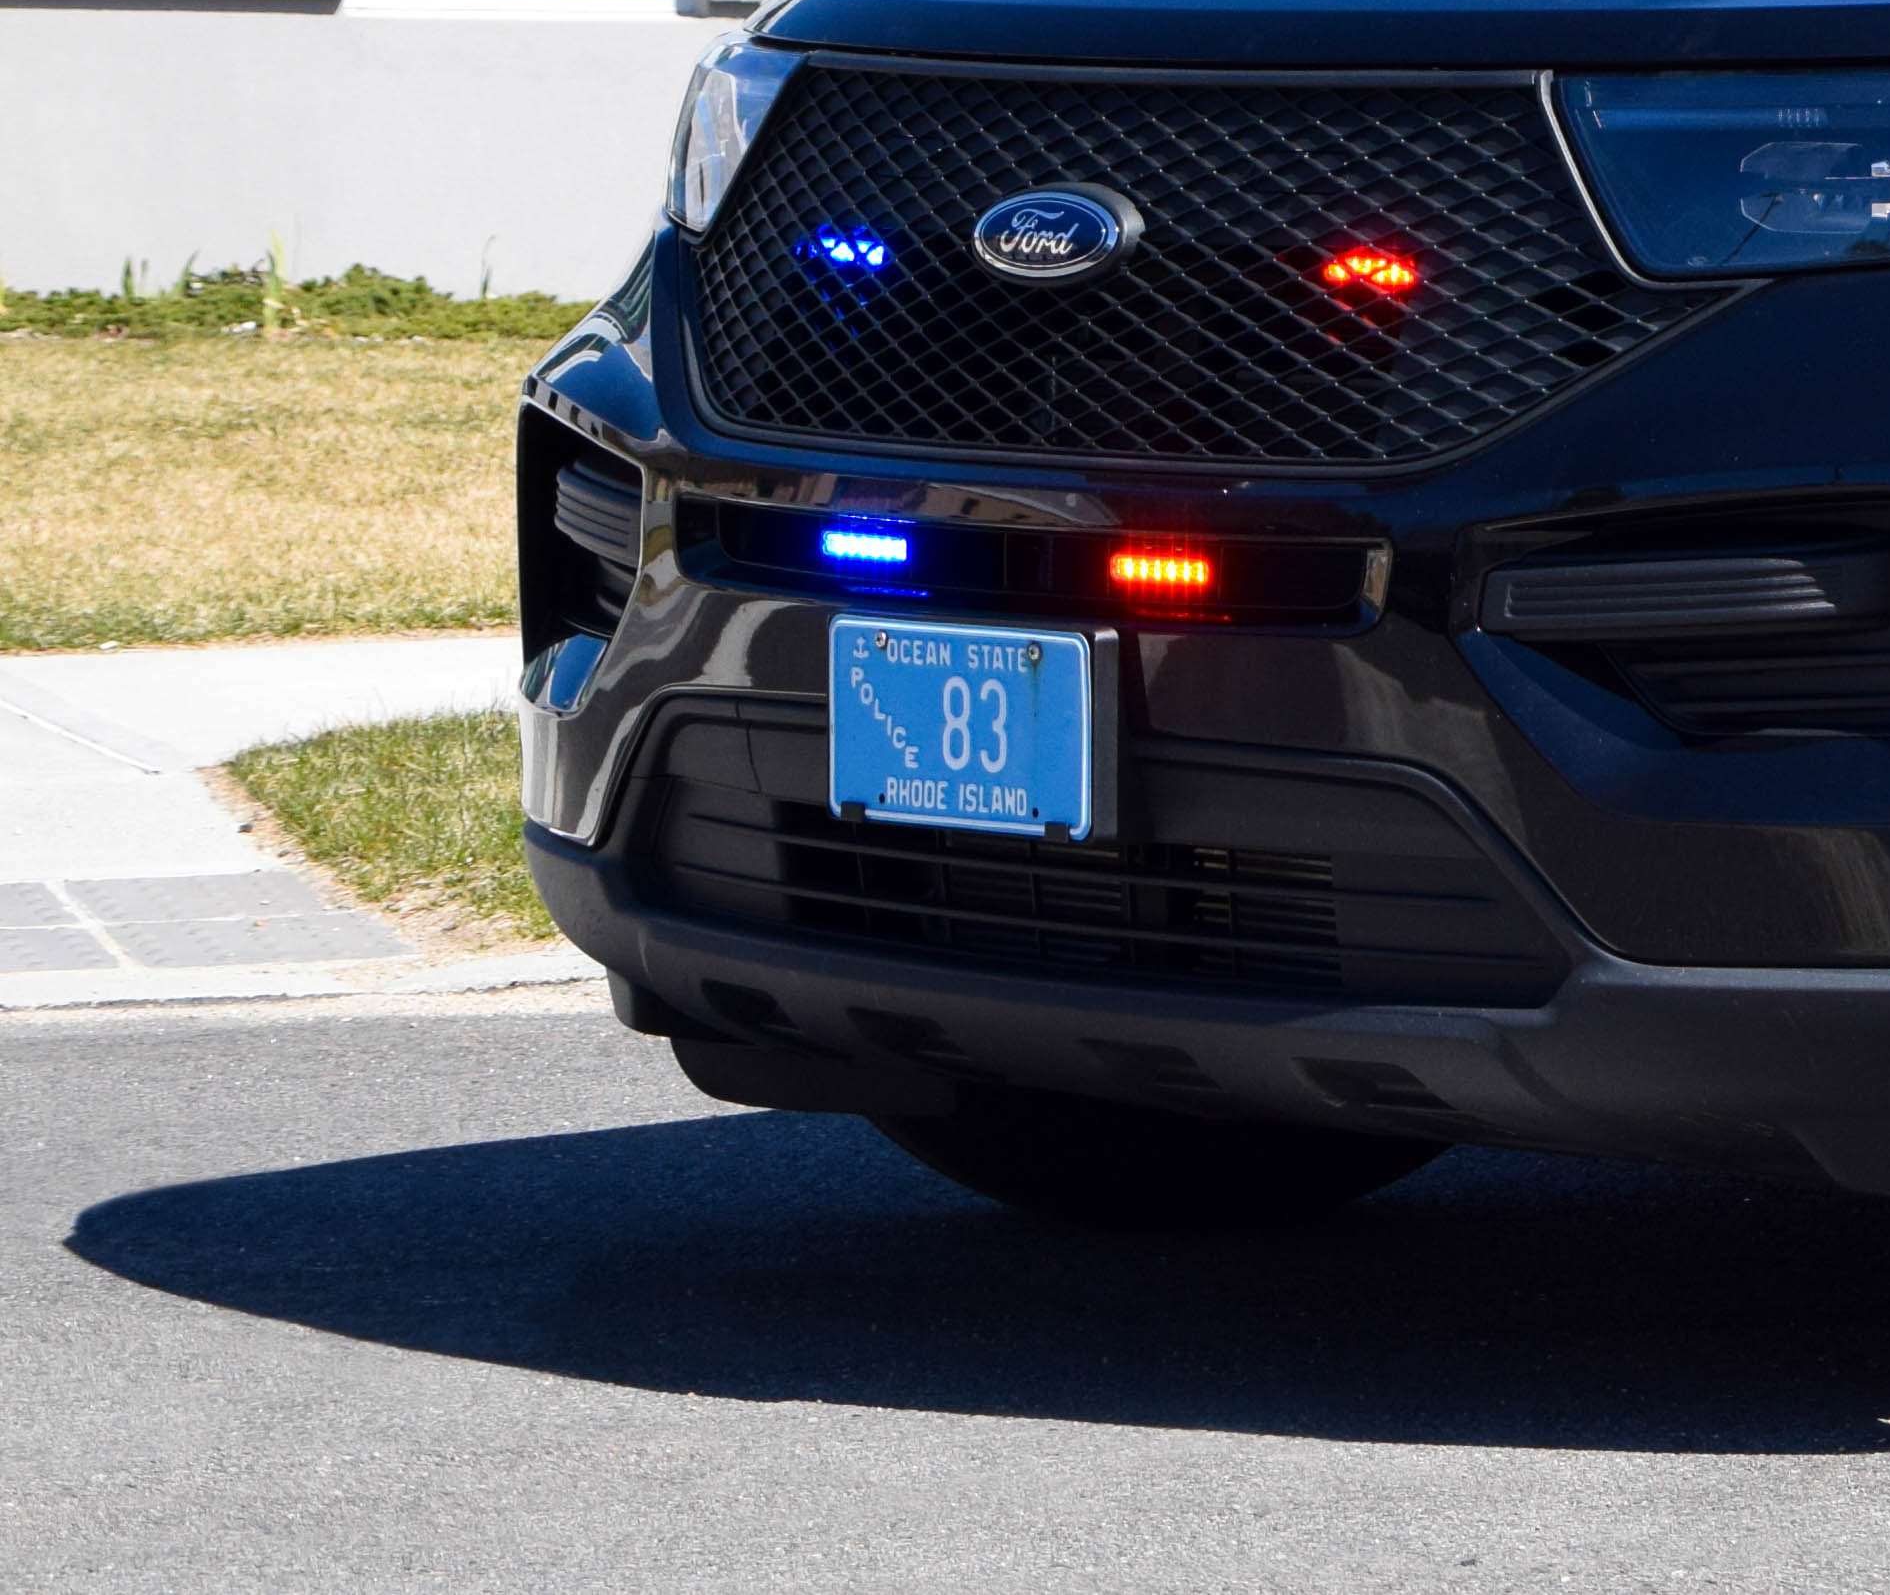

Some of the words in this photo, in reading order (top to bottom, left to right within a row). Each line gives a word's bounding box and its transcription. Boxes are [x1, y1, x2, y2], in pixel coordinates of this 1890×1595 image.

[999, 208, 1080, 255] Ford
[886, 638, 951, 666] OCEAN
[967, 645, 1029, 673] STATE
[850, 666, 919, 769] POLICE
[942, 676, 1008, 773] 83
[886, 776, 949, 810] RHODE
[958, 783, 1027, 816] ISLAND
